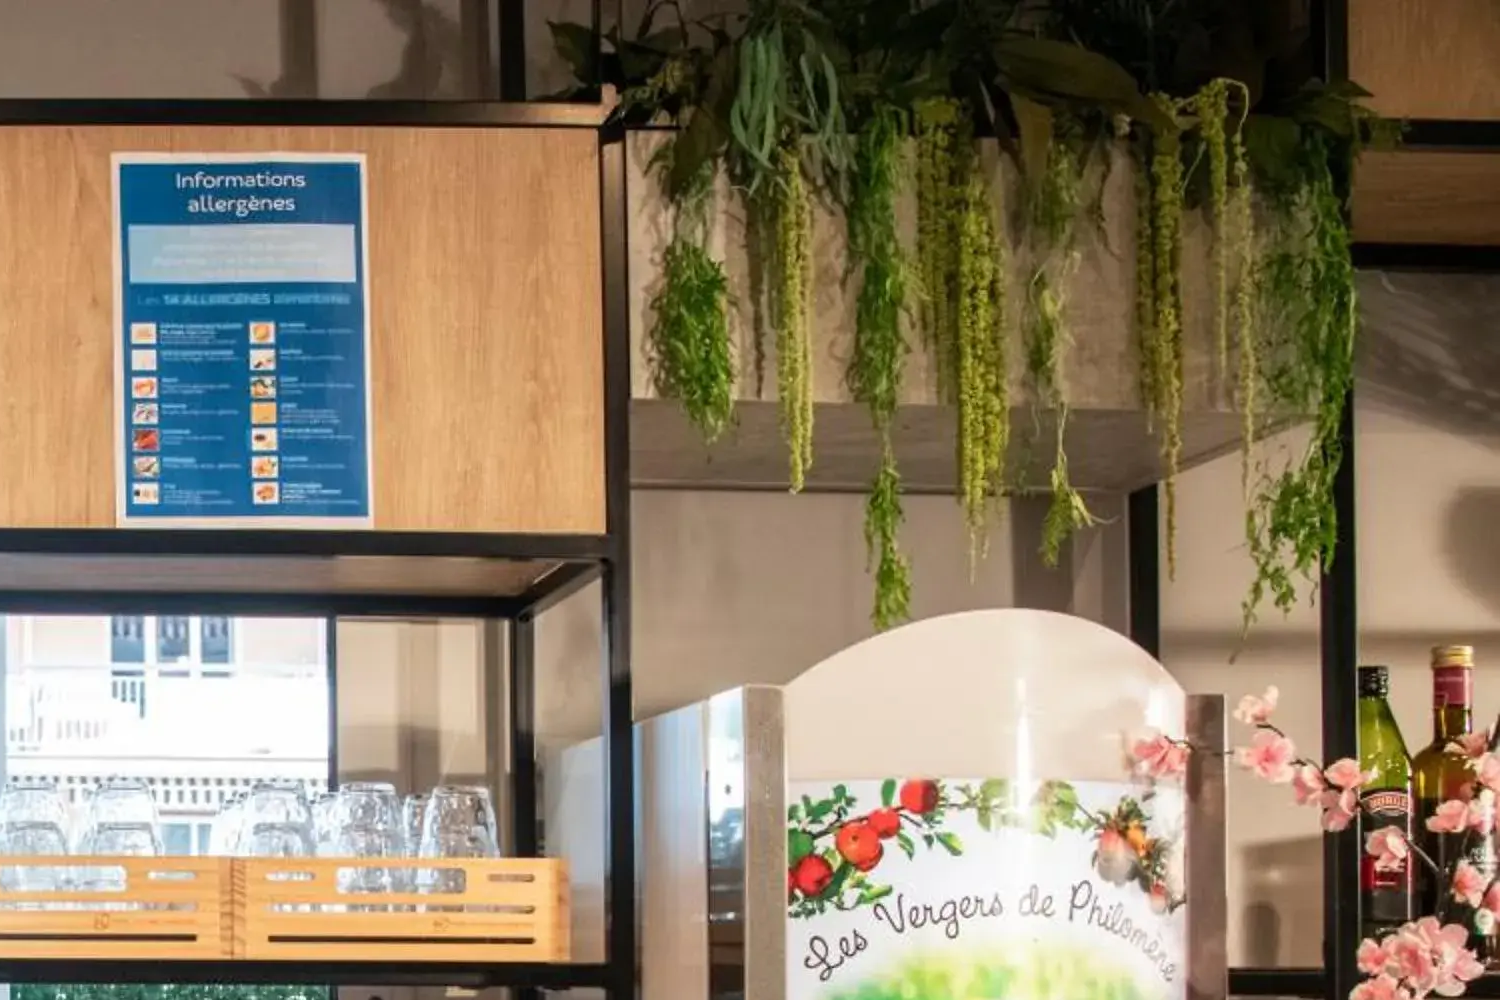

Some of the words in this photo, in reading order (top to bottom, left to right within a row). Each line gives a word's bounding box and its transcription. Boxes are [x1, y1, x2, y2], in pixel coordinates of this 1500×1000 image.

[176, 171, 306, 189] Informations
[187, 195, 296, 217] allergènes
[803, 928, 869, 982] Les
[872, 893, 1003, 939] Vergers
[1018, 884, 1056, 918] de
[1068, 880, 1177, 982] Philomène
